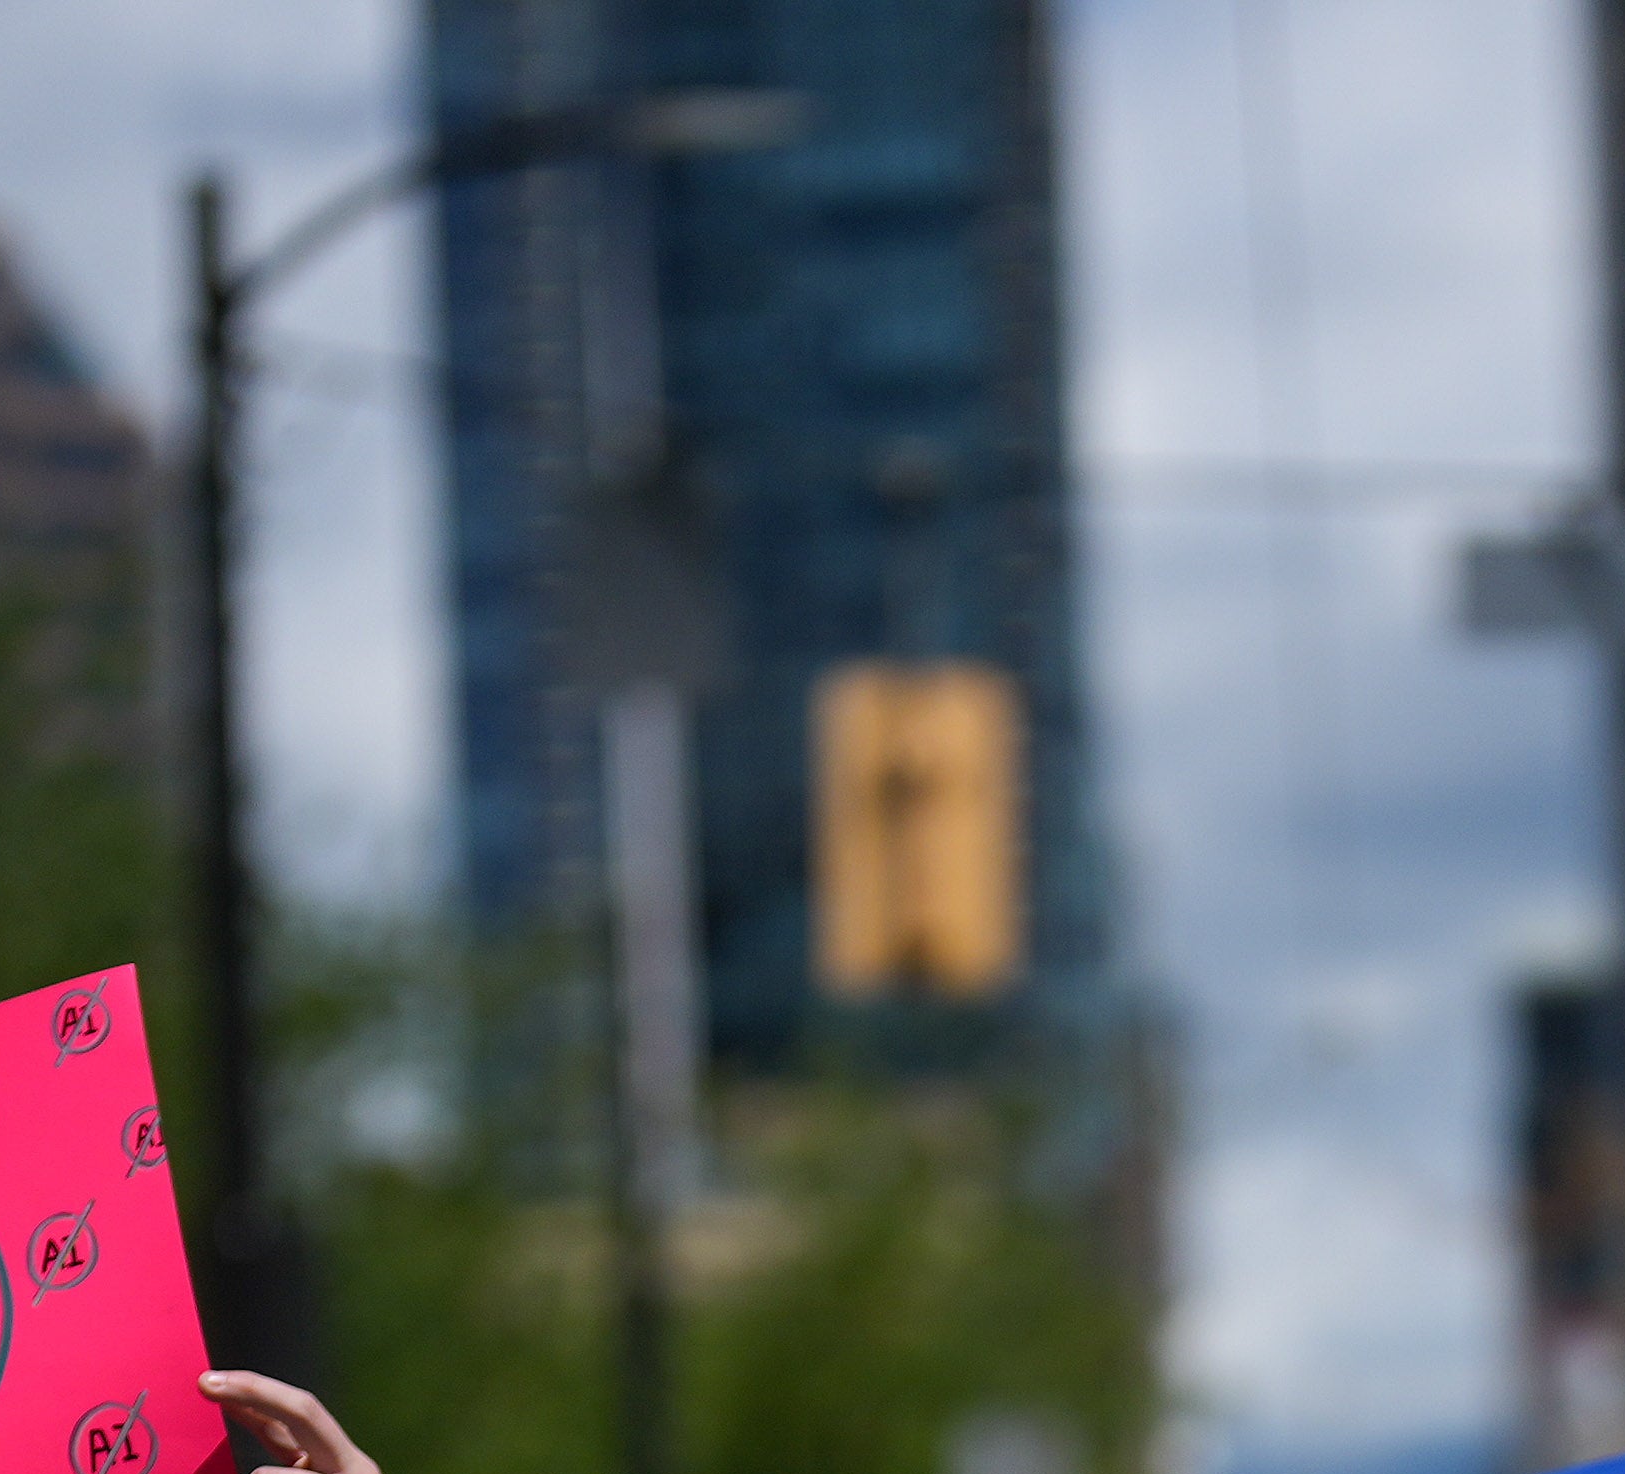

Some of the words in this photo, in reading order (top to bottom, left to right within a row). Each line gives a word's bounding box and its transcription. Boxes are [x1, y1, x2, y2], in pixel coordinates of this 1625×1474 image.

[60, 1004, 97, 1038] AI
[41, 1235, 85, 1274] AI
[88, 1423, 139, 1473] AI
